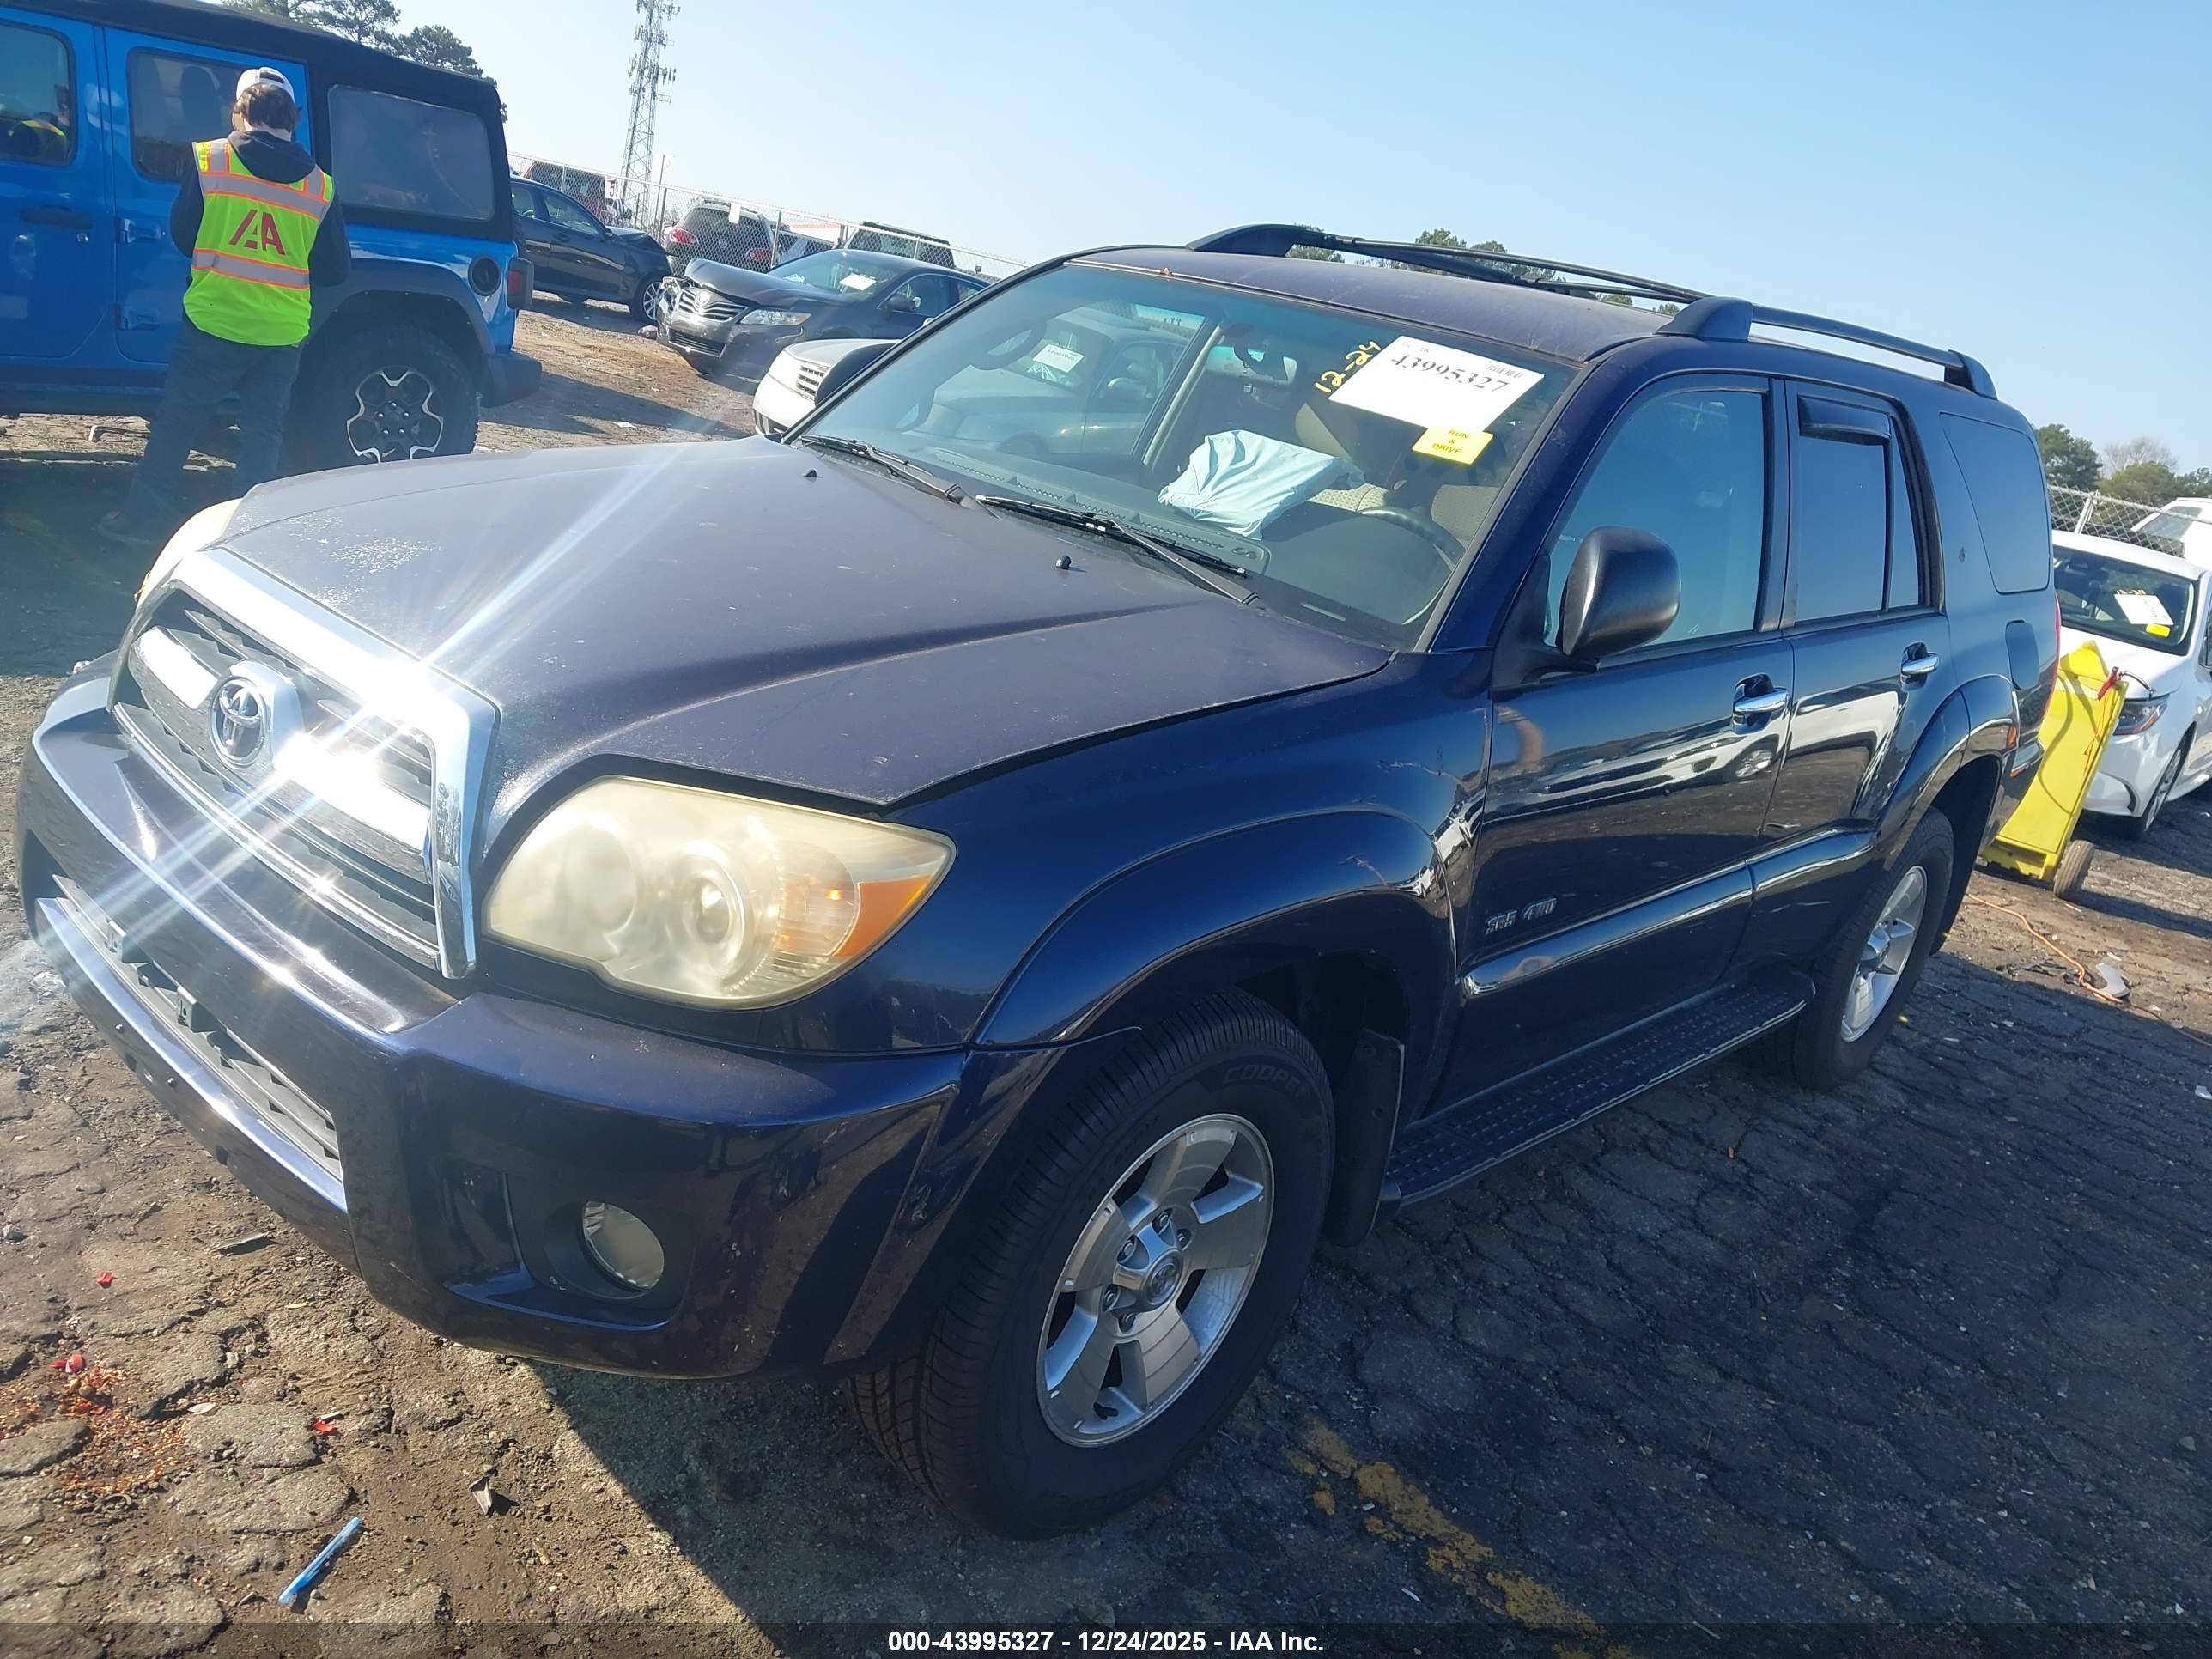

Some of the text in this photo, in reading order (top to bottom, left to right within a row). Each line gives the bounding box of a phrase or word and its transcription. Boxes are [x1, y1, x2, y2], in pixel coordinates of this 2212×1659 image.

[1314, 340, 1382, 393] 12-24
[1391, 354, 1510, 392] 43995327
[1448, 429, 1469, 439] RUN
[1431, 442, 1462, 454] DRIVE
